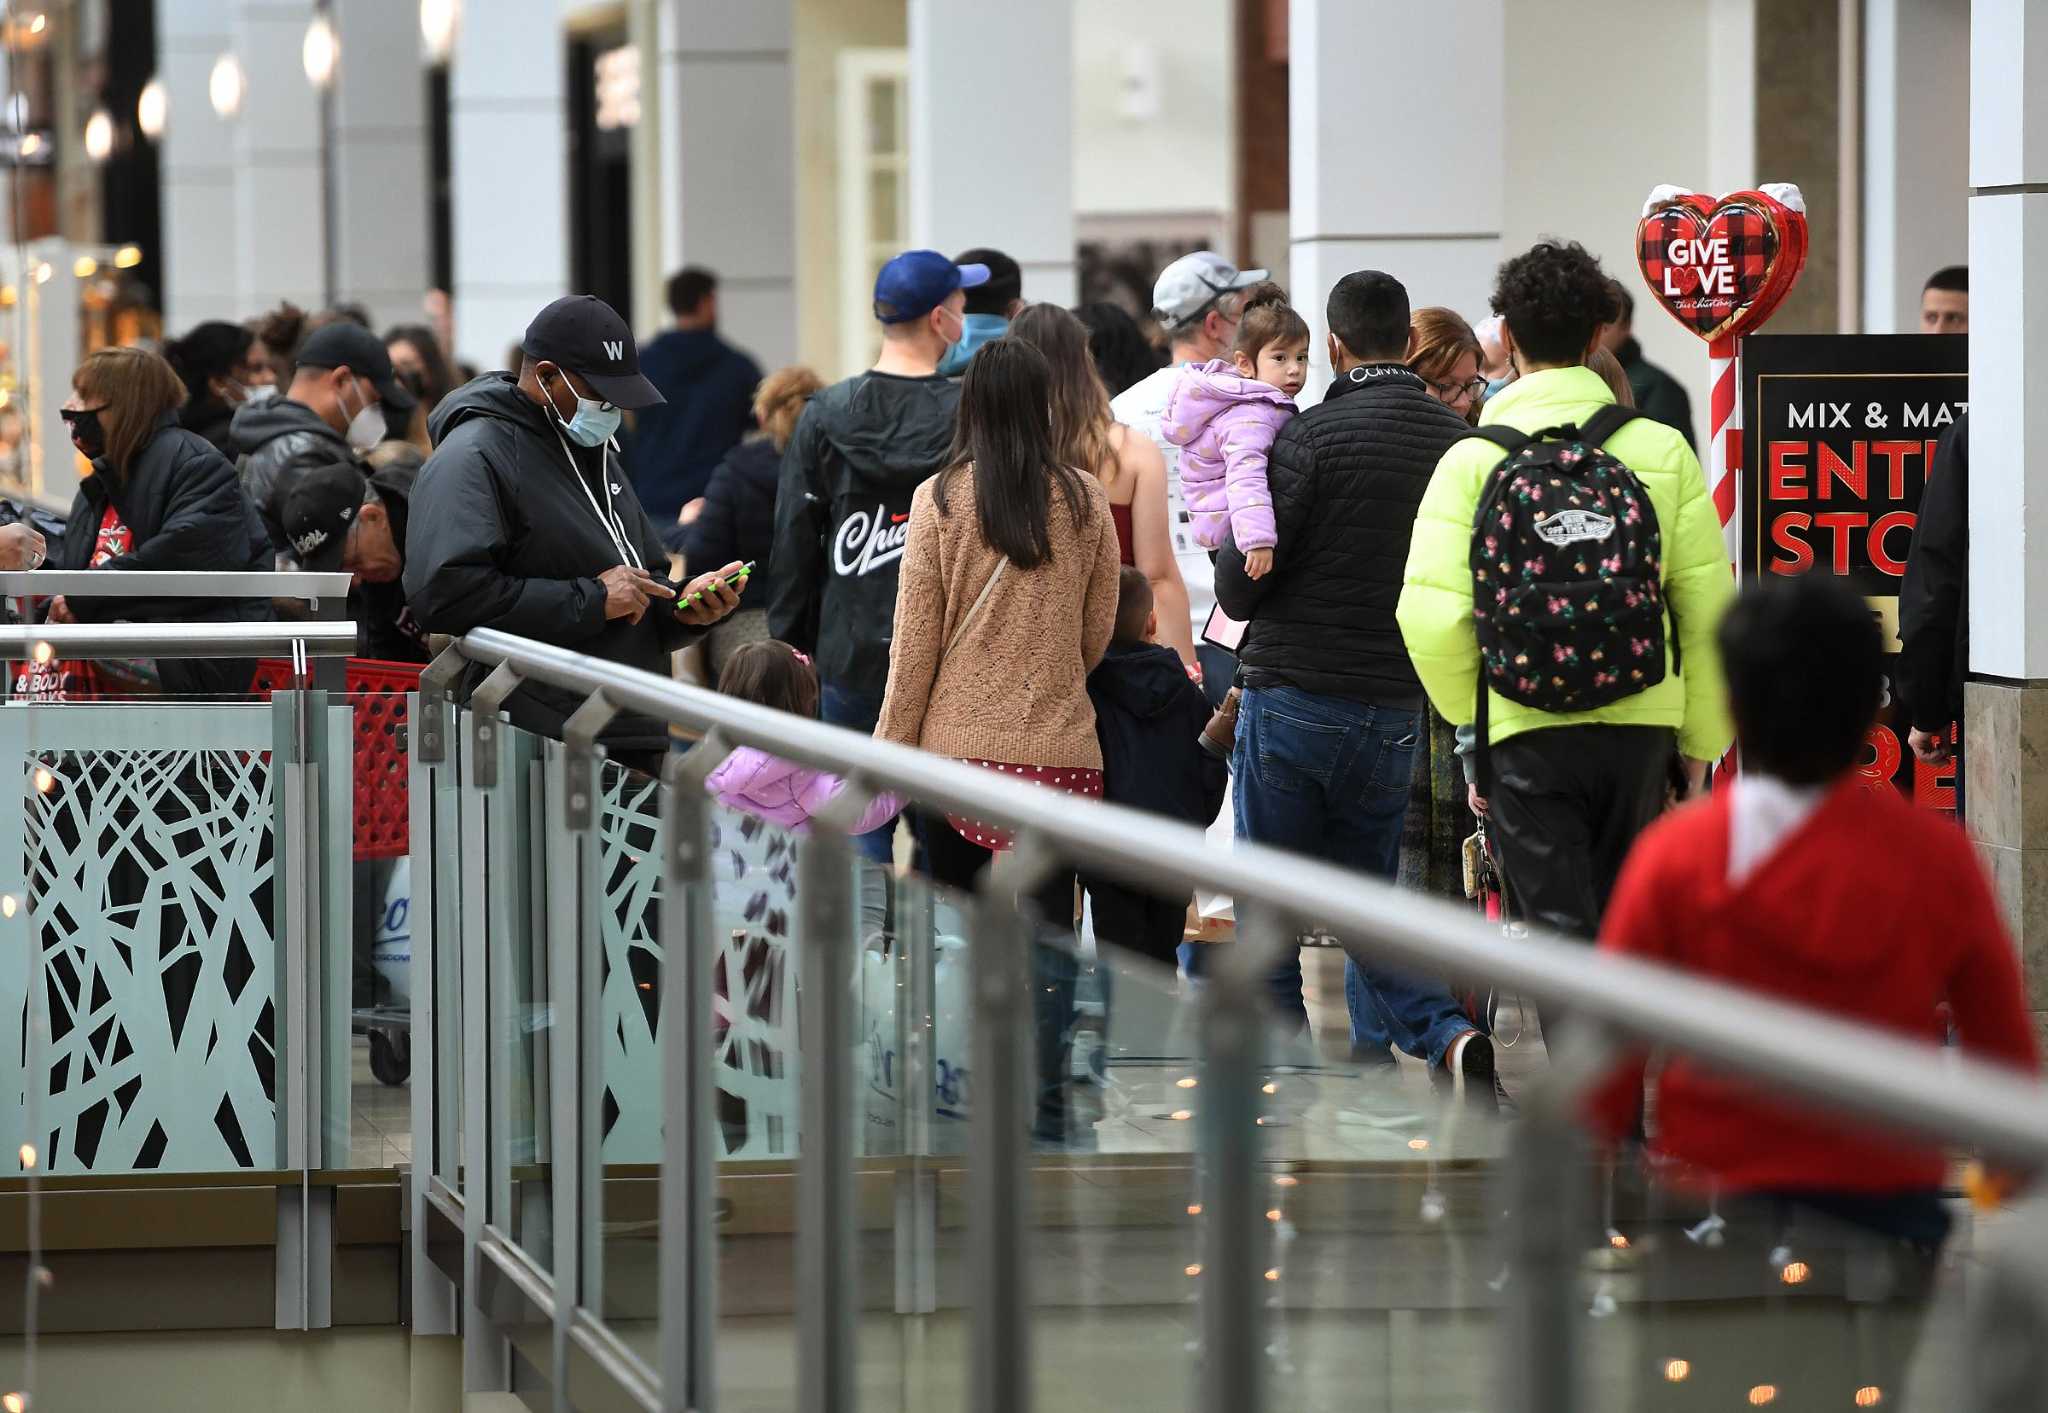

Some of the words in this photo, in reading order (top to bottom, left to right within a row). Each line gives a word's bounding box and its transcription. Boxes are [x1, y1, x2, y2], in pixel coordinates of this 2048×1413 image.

[1668, 238, 1729, 266] GIVE
[602, 340, 623, 361] W
[1788, 402, 1852, 429] MIX
[1864, 402, 1889, 429] &
[1768, 510, 1920, 577] STO
[16, 673, 29, 693] &
[29, 671, 70, 692] BODY
